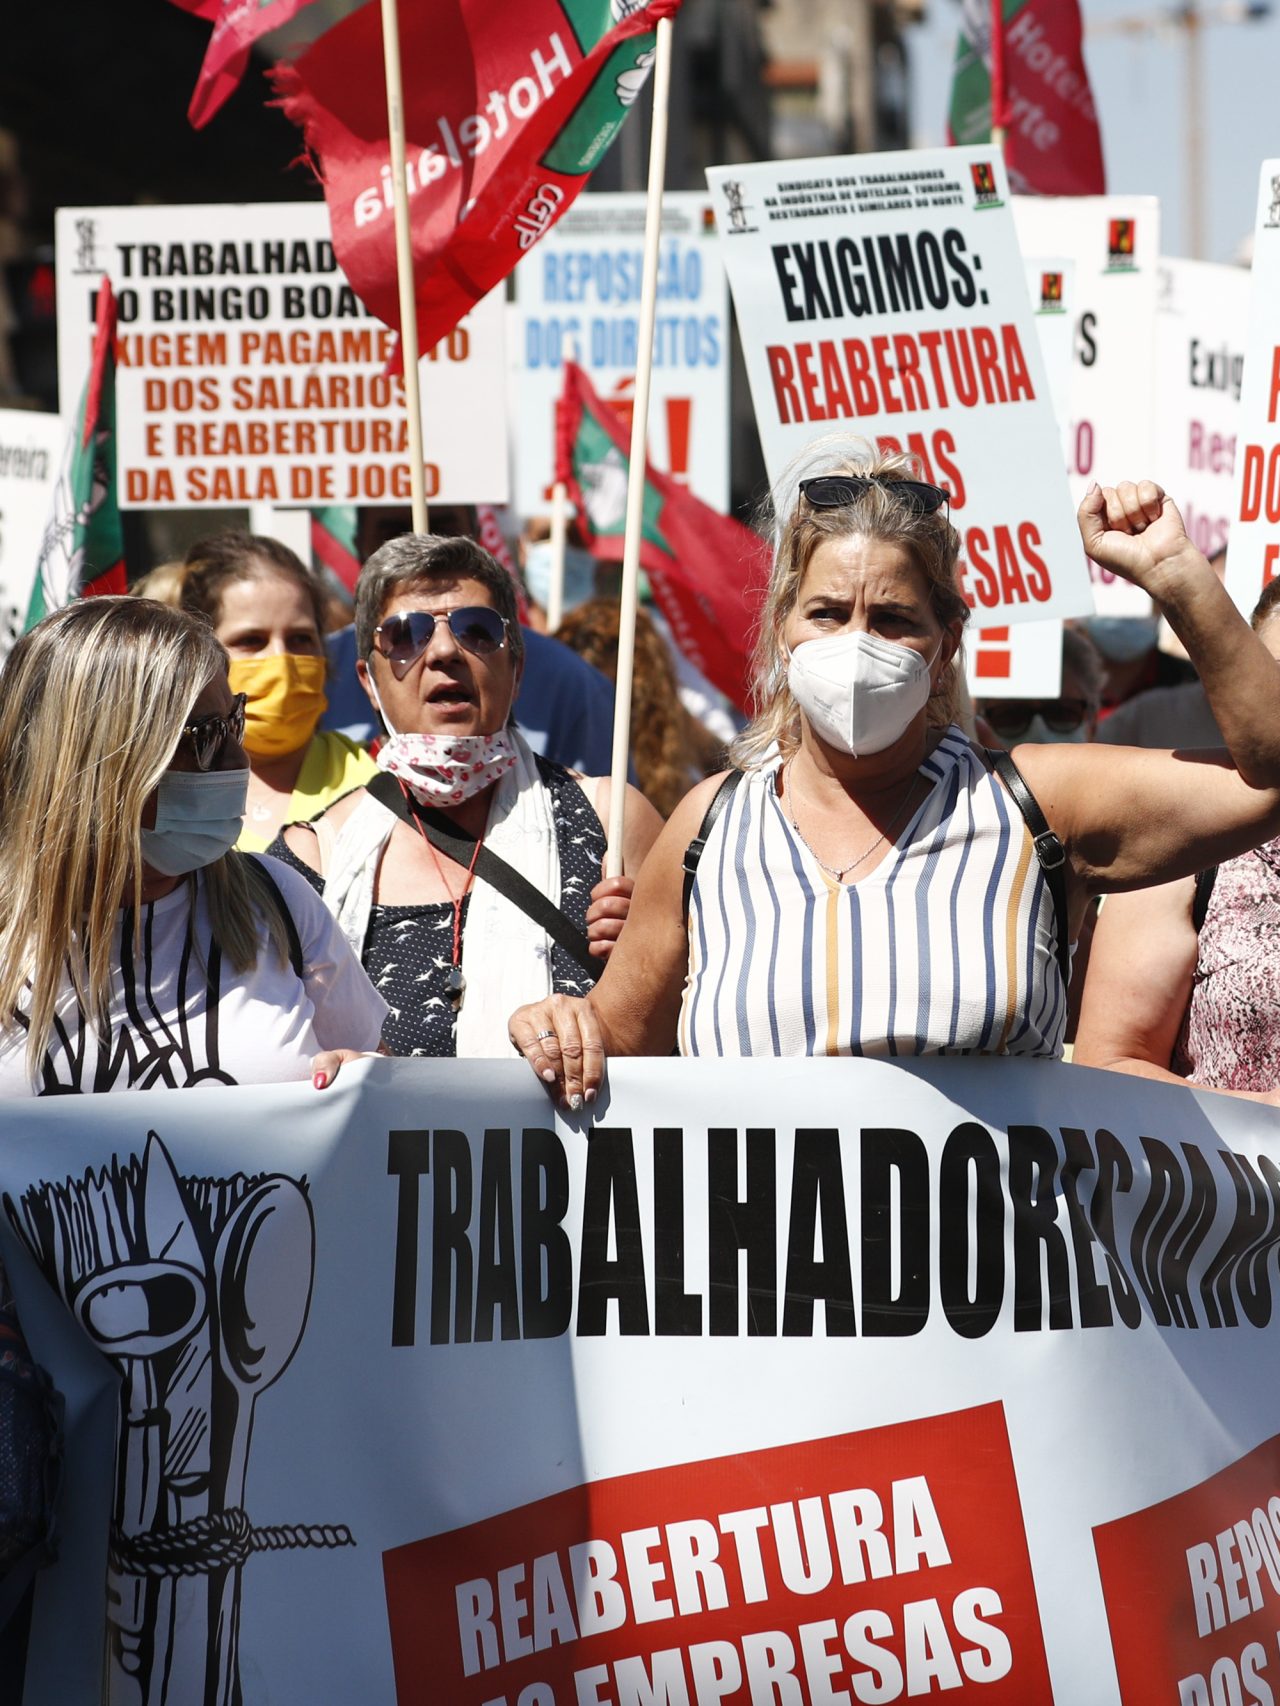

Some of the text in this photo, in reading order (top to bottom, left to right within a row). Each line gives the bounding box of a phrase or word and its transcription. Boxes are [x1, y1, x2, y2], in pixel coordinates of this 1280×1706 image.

[860, 169, 945, 185] TRABALHADORES
[116, 239, 338, 278] TRABALHAD
[543, 240, 702, 305] REPOSIÃO
[771, 228, 990, 322] EXIGIMOS:
[90, 288, 139, 323] O
[153, 286, 271, 322] BINGO
[91, 327, 470, 367] XIGEM PAGAMEO
[766, 323, 1036, 424] REABERTURA
[144, 377, 220, 413] DOS
[146, 423, 163, 457] E
[126, 463, 441, 502] DA SALA DE JOGO
[387, 1122, 1141, 1347] TRABALHADORES
[1131, 1136, 1218, 1329] DA
[455, 1475, 952, 1678] REABERTURA
